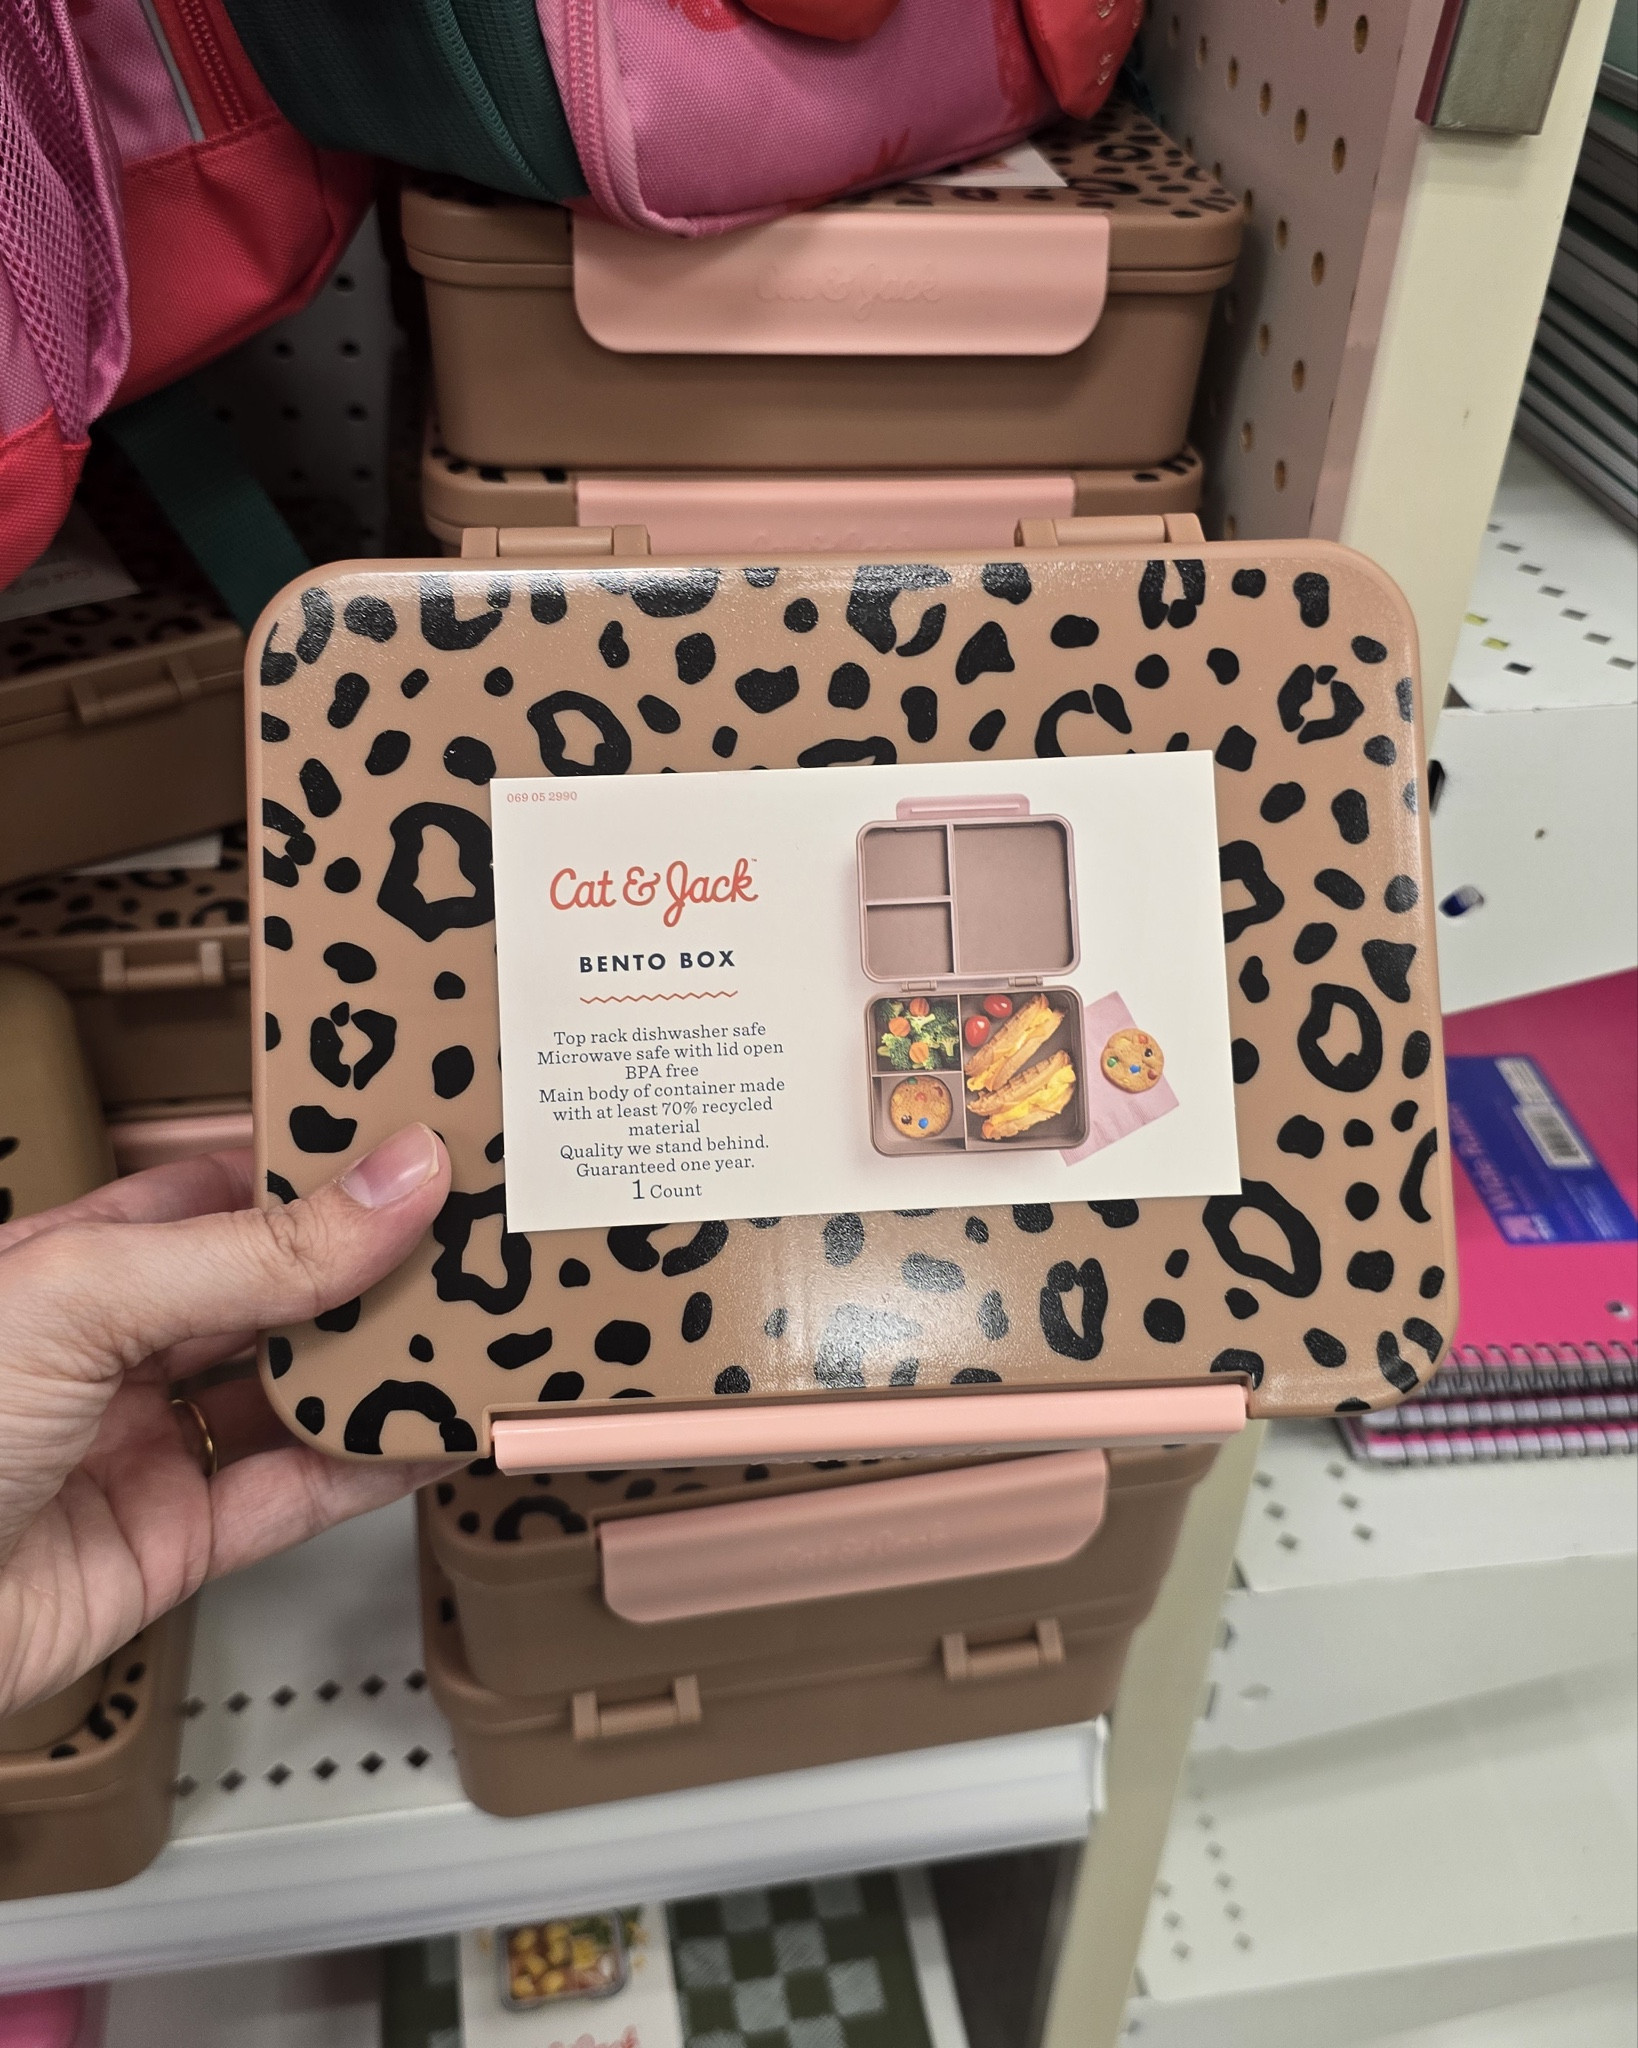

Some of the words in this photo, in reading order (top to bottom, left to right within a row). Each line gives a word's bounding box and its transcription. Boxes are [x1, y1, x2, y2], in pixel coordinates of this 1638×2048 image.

[507, 793, 529, 803] 069
[531, 792, 546, 802] 05
[548, 791, 578, 801] 2990
[550, 867, 617, 910] Cat
[622, 866, 661, 906] &
[579, 953, 666, 973] BENTO
[680, 950, 736, 969] BOX
[553, 1031, 586, 1047] Top
[591, 1028, 628, 1043] rack
[632, 1025, 728, 1042] dishwasher
[733, 1022, 767, 1038] safe
[537, 1050, 632, 1065] Microwave
[636, 1046, 670, 1061] safe
[674, 1044, 713, 1058] with
[717, 1042, 739, 1056] lid
[743, 1042, 784, 1057] open
[625, 1066, 662, 1080] BPA
[666, 1064, 699, 1077] free
[539, 1088, 584, 1103] Main
[588, 1086, 629, 1102] body
[633, 1084, 651, 1098] of
[654, 1082, 736, 1097] container
[740, 1078, 786, 1093] made
[553, 1106, 592, 1121] with
[597, 1107, 613, 1119] at
[617, 1103, 658, 1118] least
[662, 1102, 698, 1116] 70%
[702, 1097, 773, 1115] recycled
[629, 1119, 701, 1136] material
[560, 1143, 623, 1161] Quality
[628, 1144, 651, 1155] we
[655, 1138, 702, 1154] stand
[707, 1135, 769, 1151] behind.
[576, 1159, 676, 1177] Guaranteed
[680, 1157, 711, 1171] one
[714, 1156, 755, 1172] year.
[632, 1179, 645, 1199] 1
[650, 1183, 702, 1199] Count
